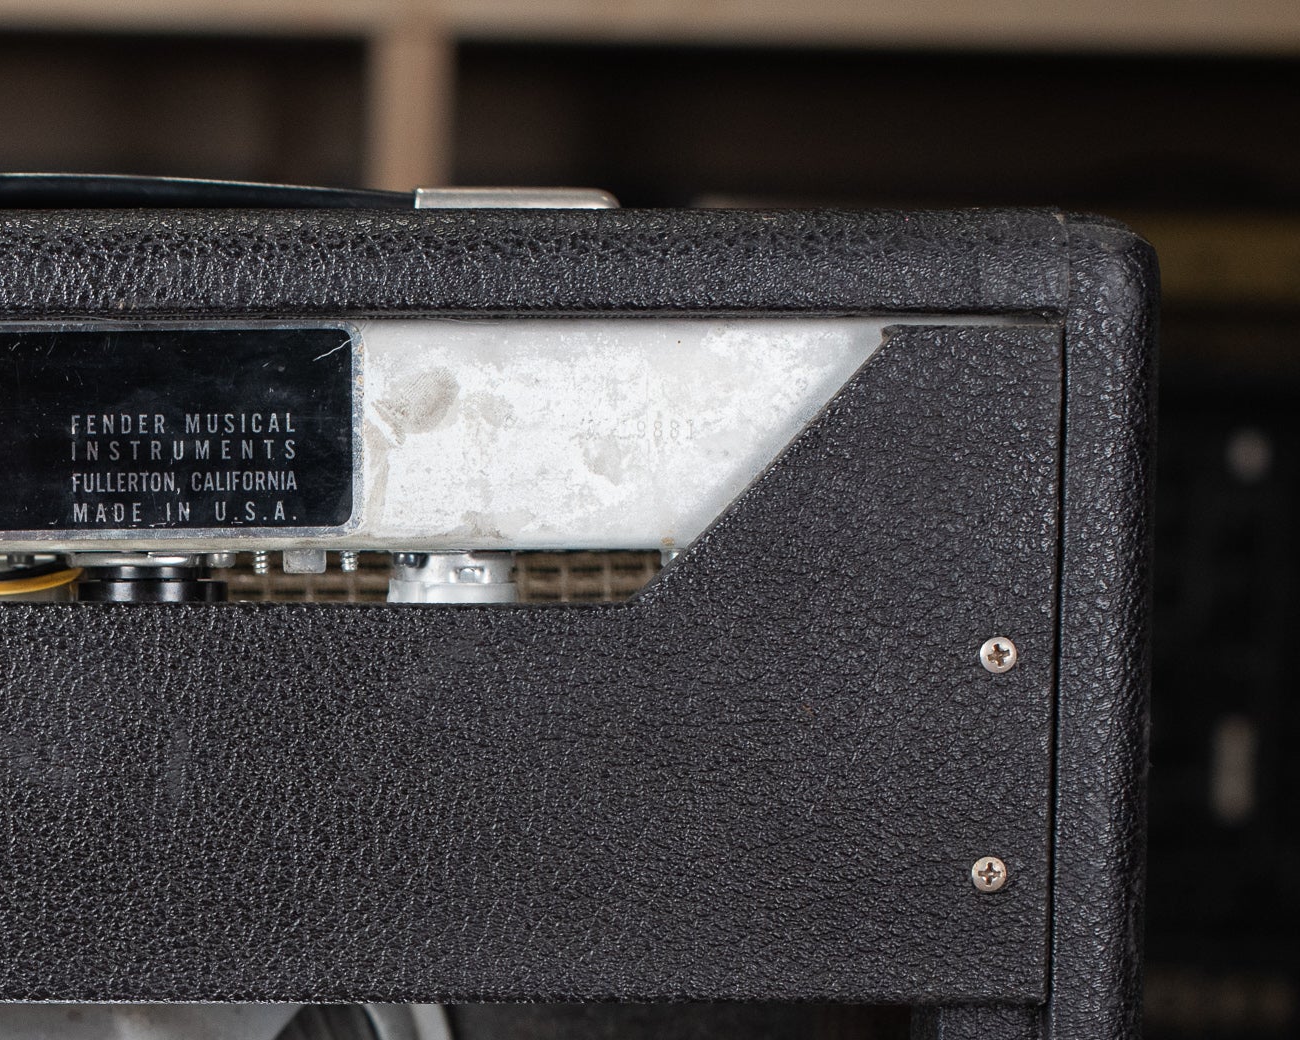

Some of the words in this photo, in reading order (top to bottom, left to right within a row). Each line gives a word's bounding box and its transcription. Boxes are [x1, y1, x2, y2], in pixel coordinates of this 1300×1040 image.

[71, 414, 166, 435] FENDER
[186, 413, 296, 434] MUSICAL
[71, 440, 297, 461] INSTRUMENTS
[72, 471, 181, 494] FULLERTON,
[191, 469, 298, 491] CALIFORNIA
[73, 502, 142, 523] MADE
[166, 501, 190, 522] IN
[215, 500, 298, 522] U.S.A.
